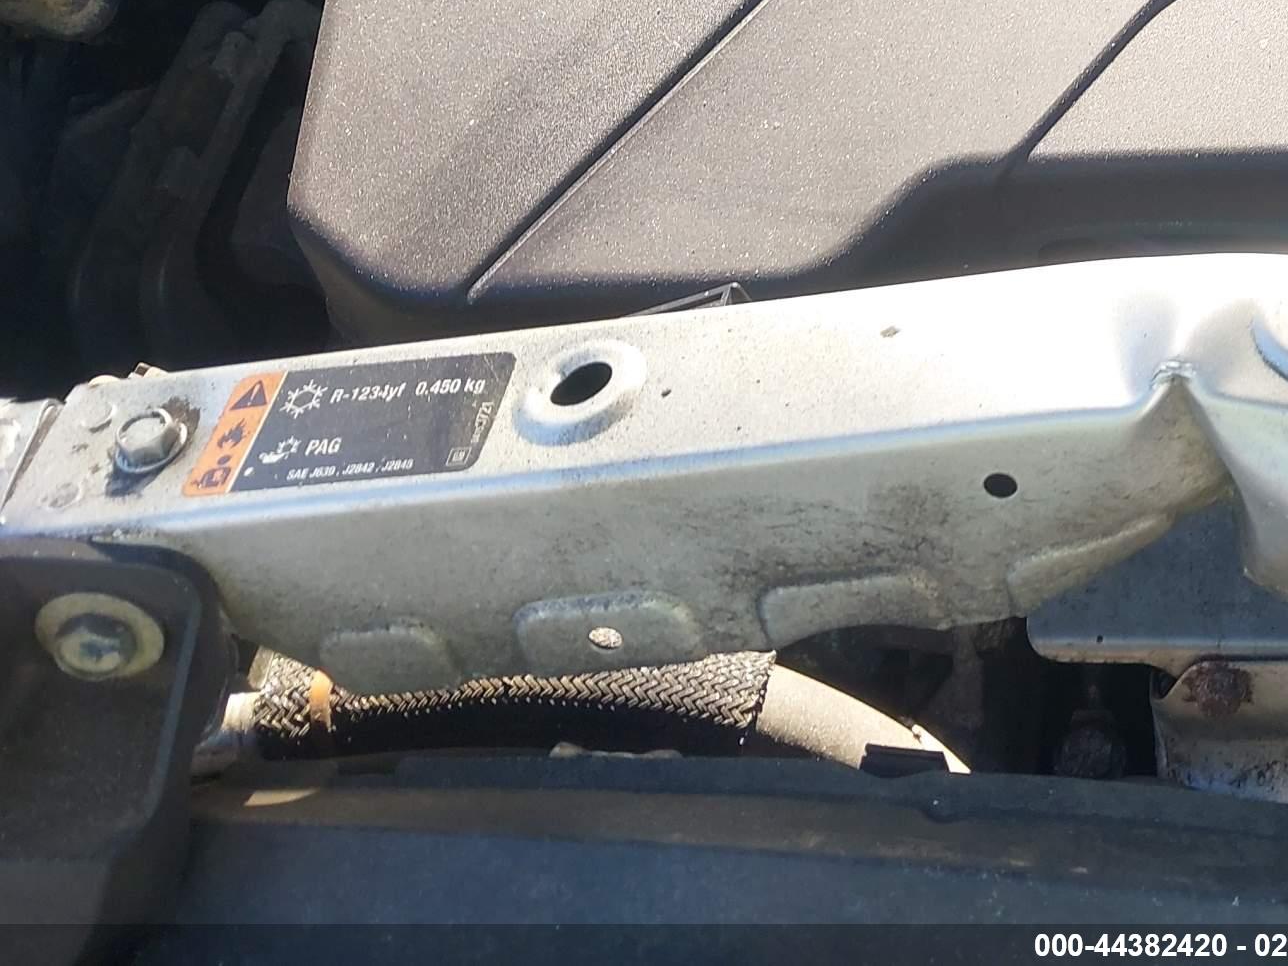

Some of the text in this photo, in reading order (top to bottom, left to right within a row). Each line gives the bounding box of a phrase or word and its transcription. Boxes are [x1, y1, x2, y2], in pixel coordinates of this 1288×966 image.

[330, 377, 485, 403] R-1234yf 0.450 kg
[305, 438, 342, 455] PAG
[287, 469, 308, 480] SAE
